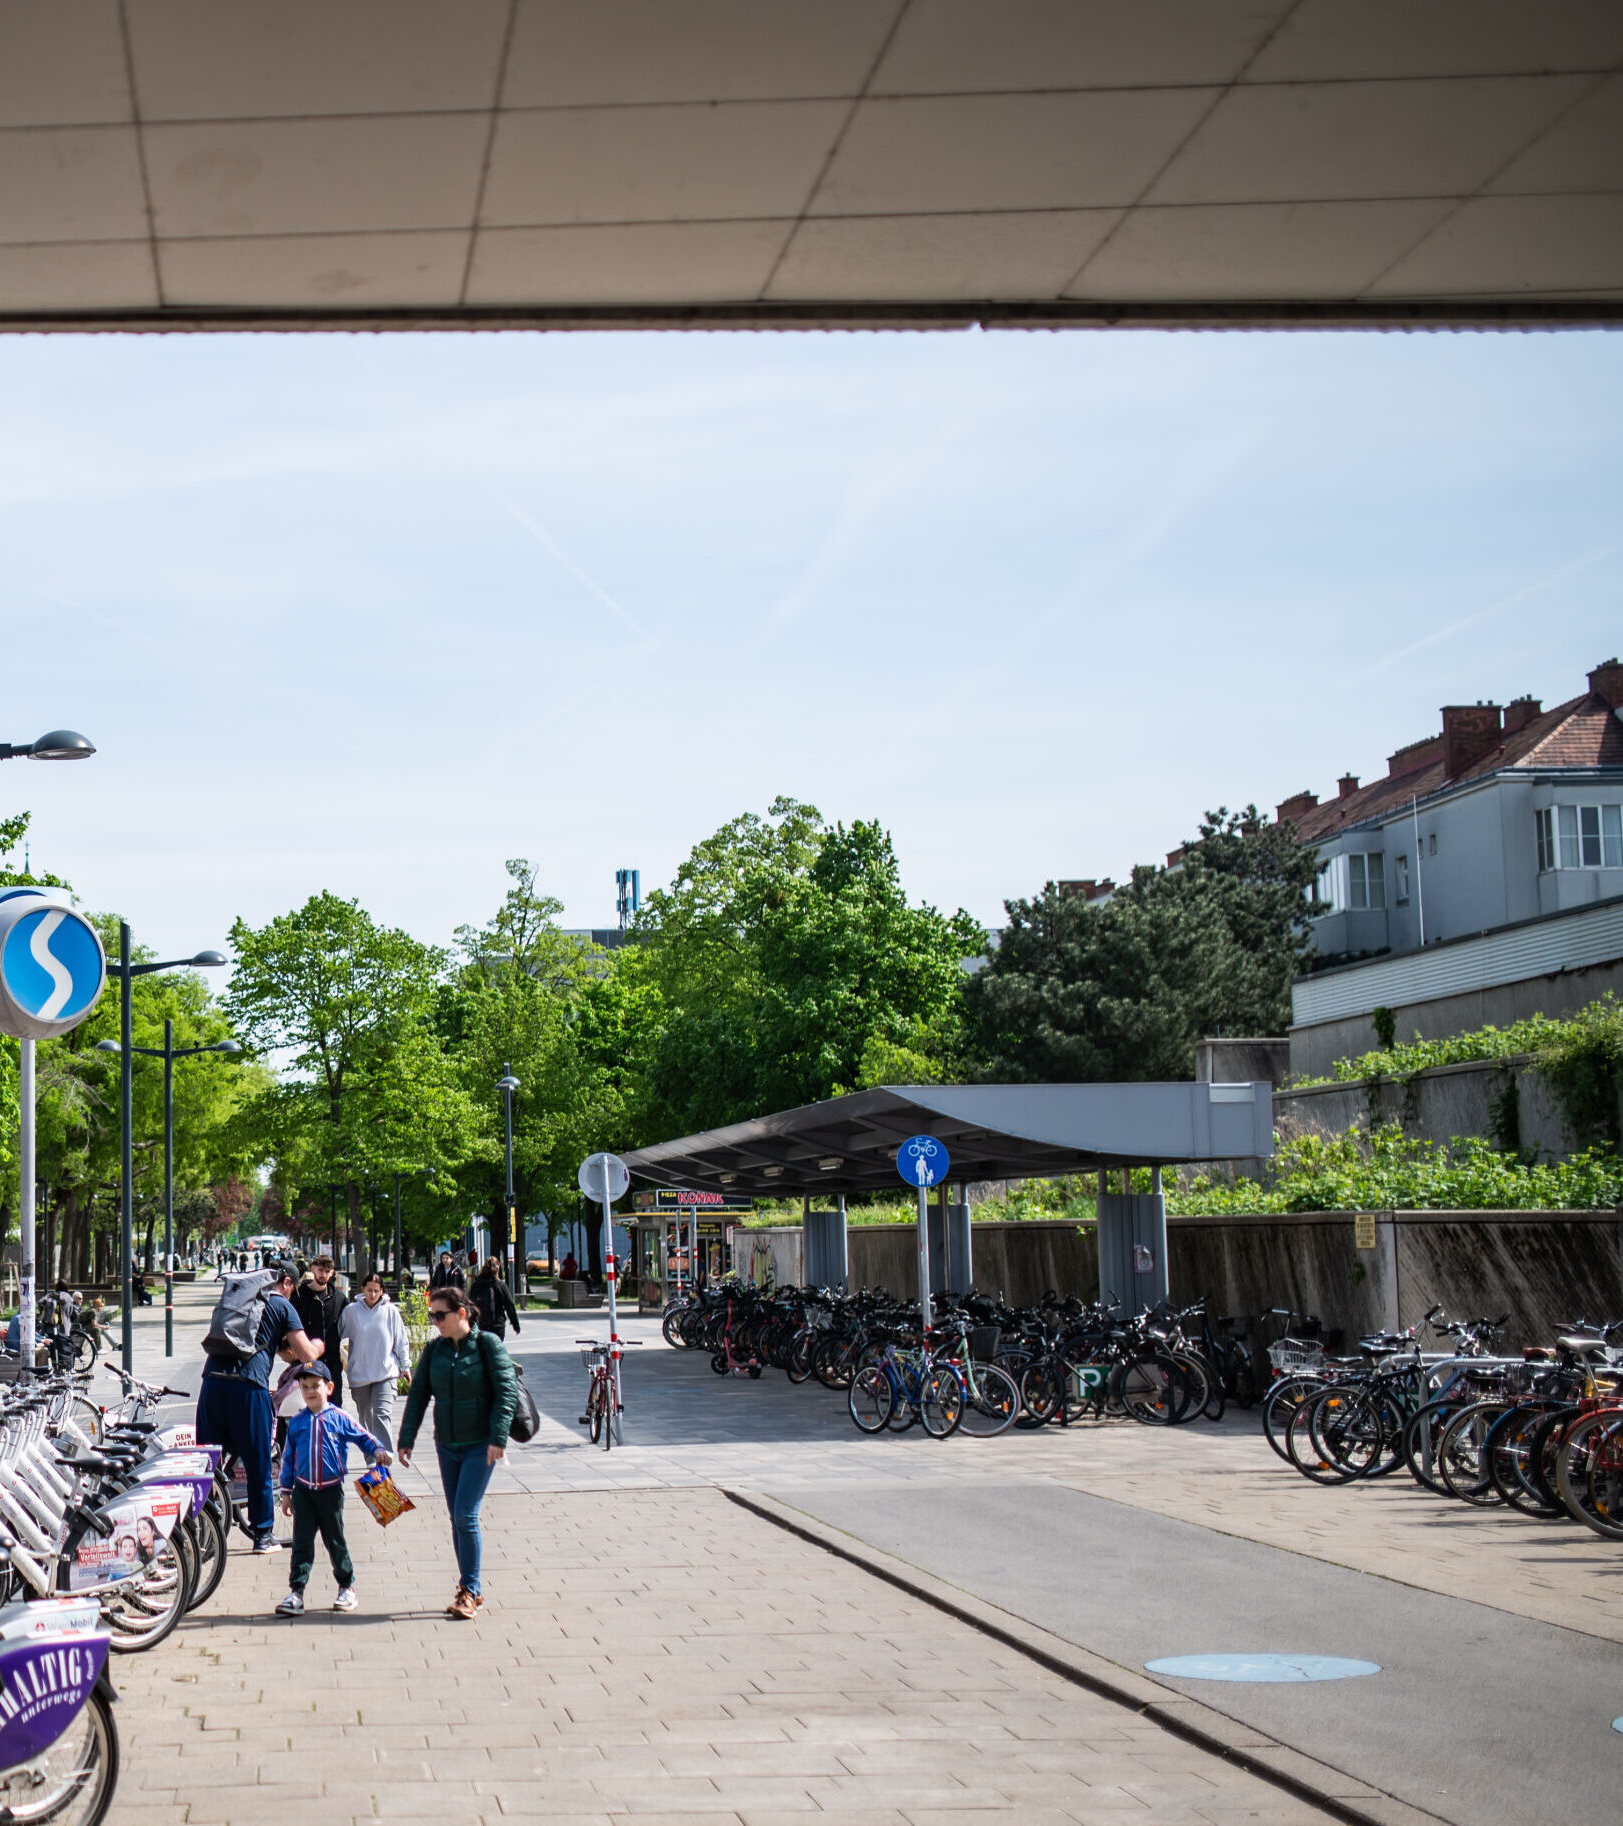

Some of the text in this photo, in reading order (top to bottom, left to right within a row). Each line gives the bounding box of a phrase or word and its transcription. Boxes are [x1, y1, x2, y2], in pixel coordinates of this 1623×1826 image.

[678, 1191, 724, 1204] KONAK
[175, 1432, 192, 1441] DEIN
[21, 1688, 82, 1724] unterwegs
